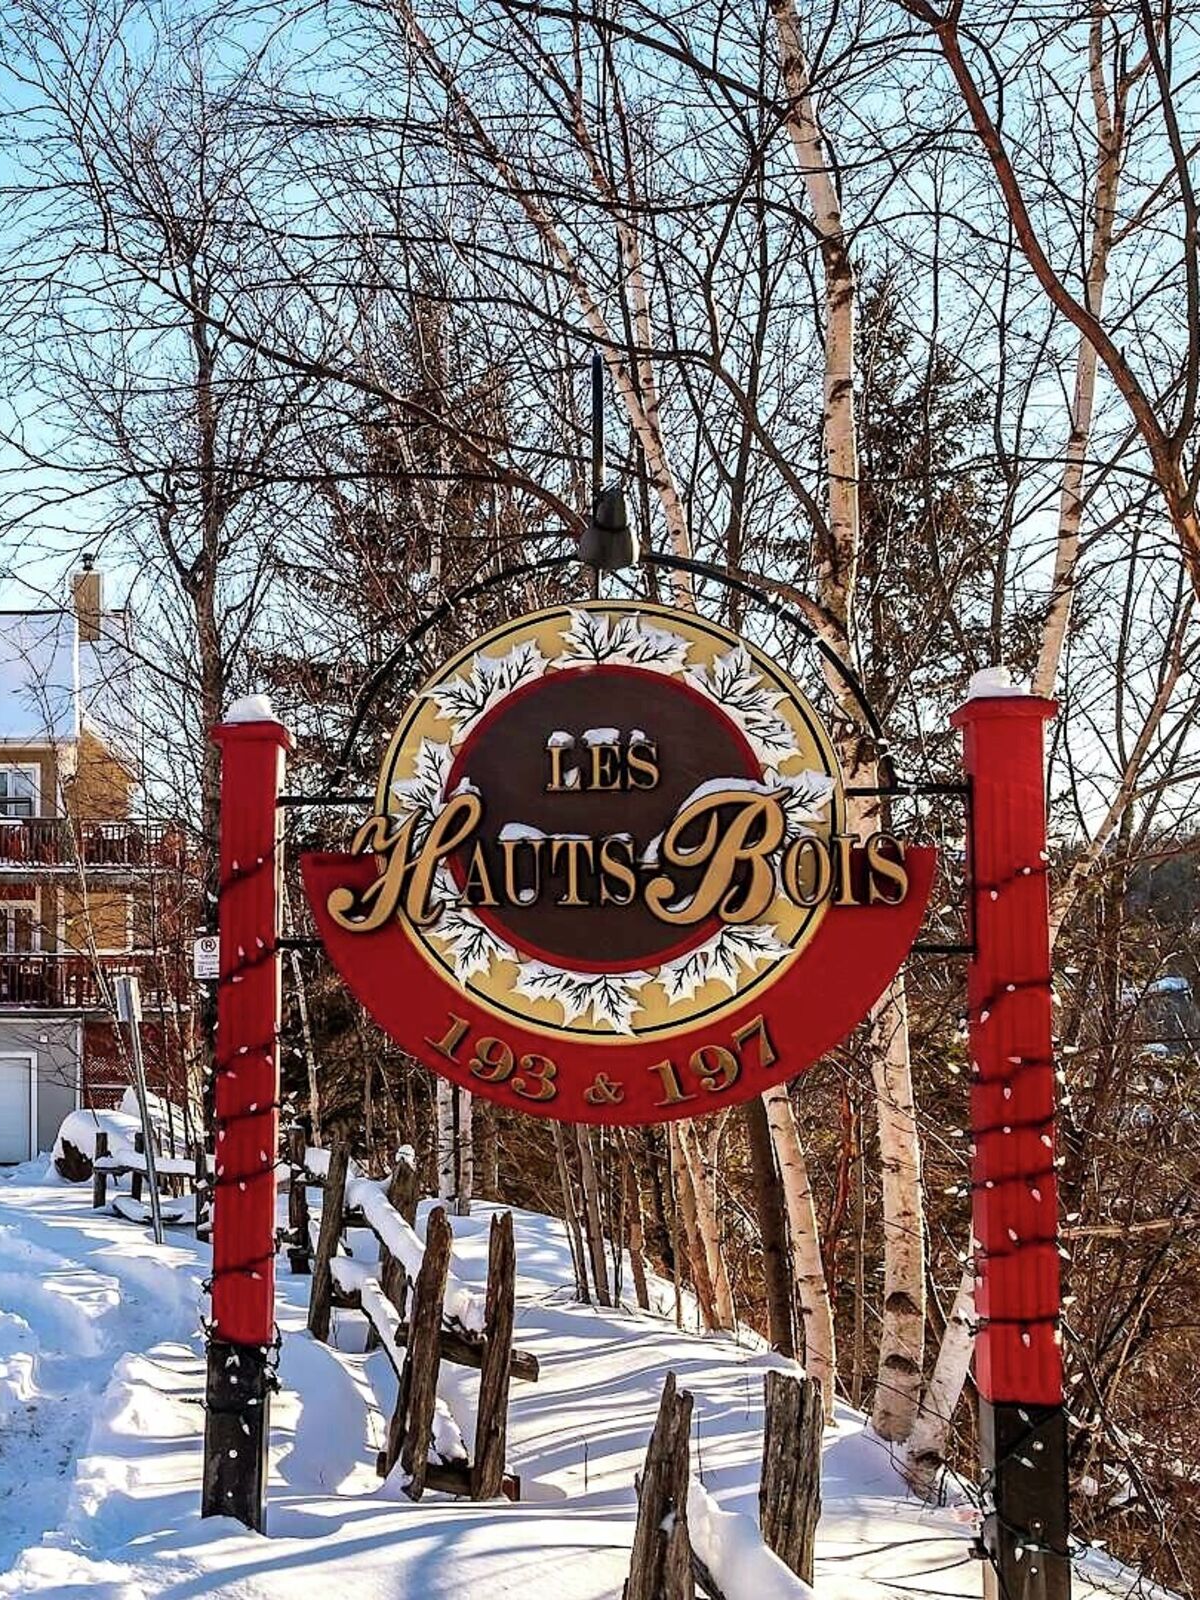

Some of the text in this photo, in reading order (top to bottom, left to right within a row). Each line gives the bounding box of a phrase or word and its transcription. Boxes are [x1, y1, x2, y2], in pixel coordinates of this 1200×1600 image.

[546, 740, 659, 791] LES
[424, 1011, 776, 1107] 193 & 197
